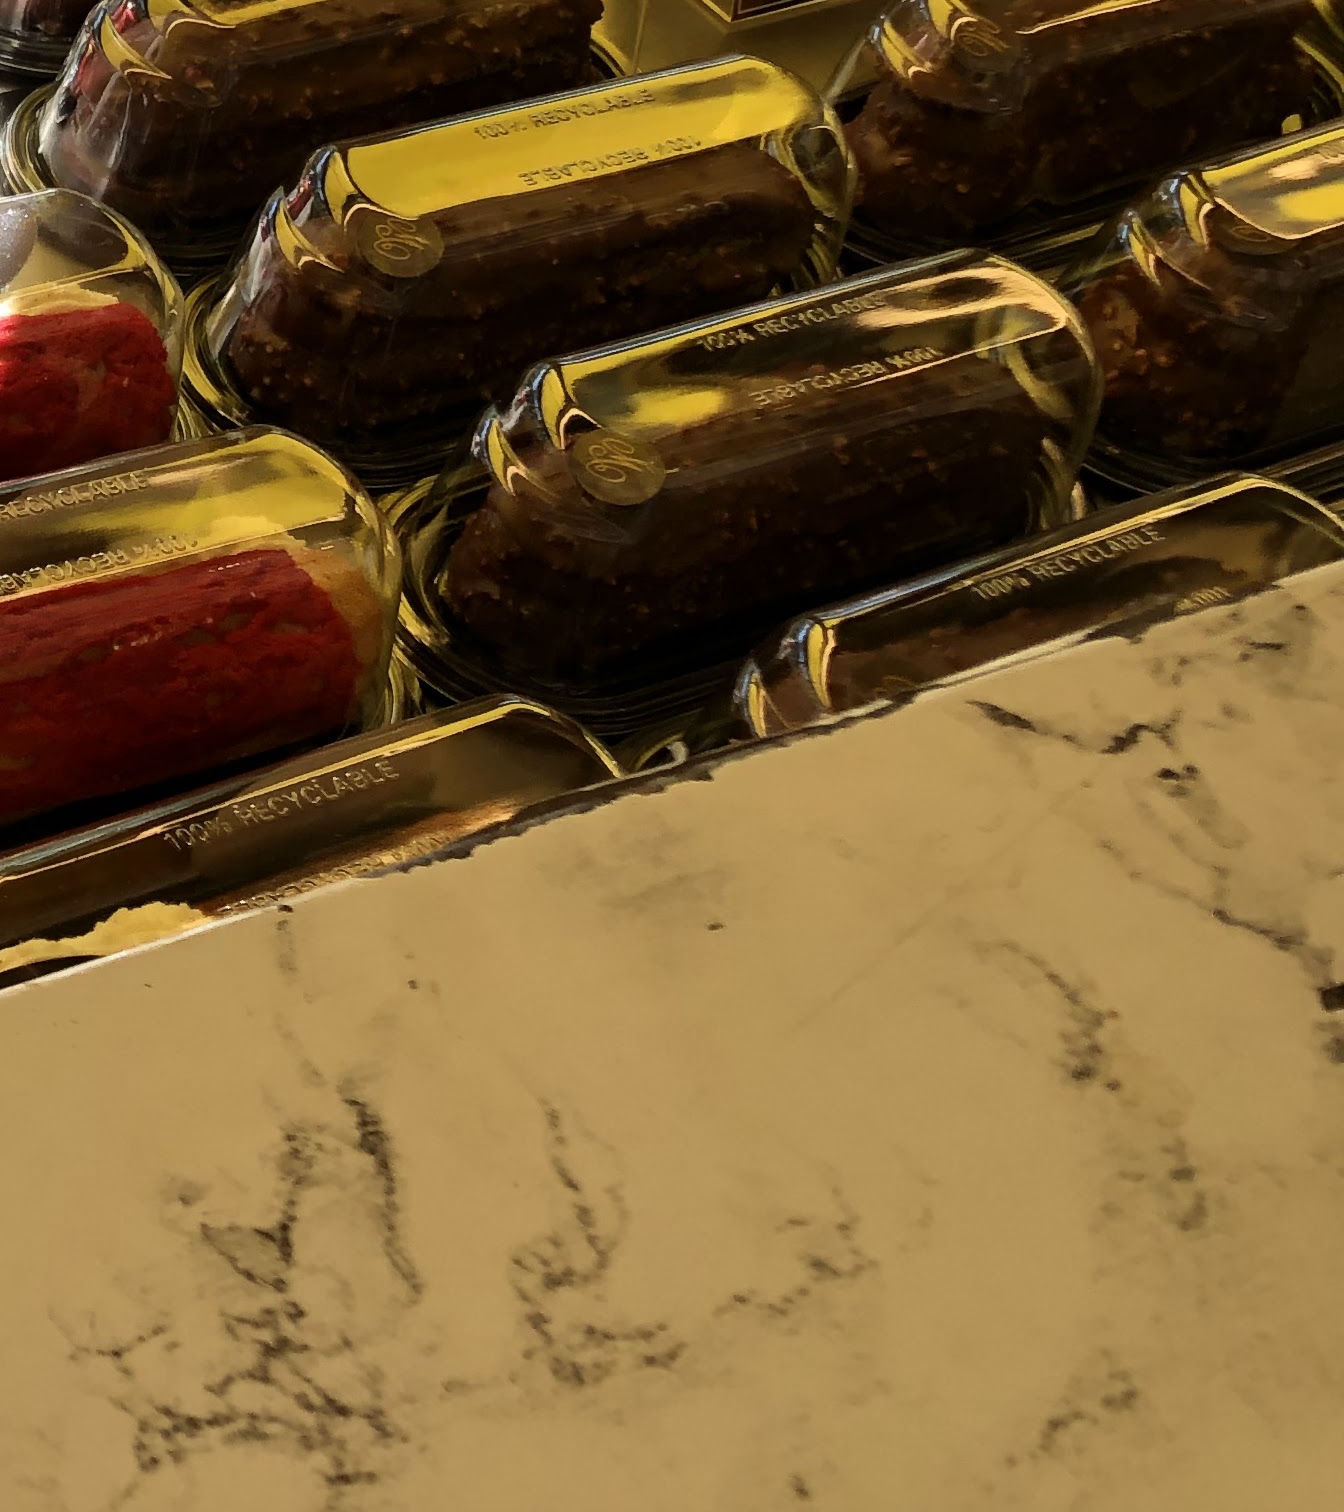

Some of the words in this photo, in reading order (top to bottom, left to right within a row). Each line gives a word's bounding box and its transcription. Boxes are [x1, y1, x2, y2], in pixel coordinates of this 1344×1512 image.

[529, 88, 655, 128] RECYCLABLE
[518, 149, 648, 187] RECYCLABLE
[1025, 526, 1166, 581] RECYCLABLE
[232, 758, 401, 829] RECYCLABLE
